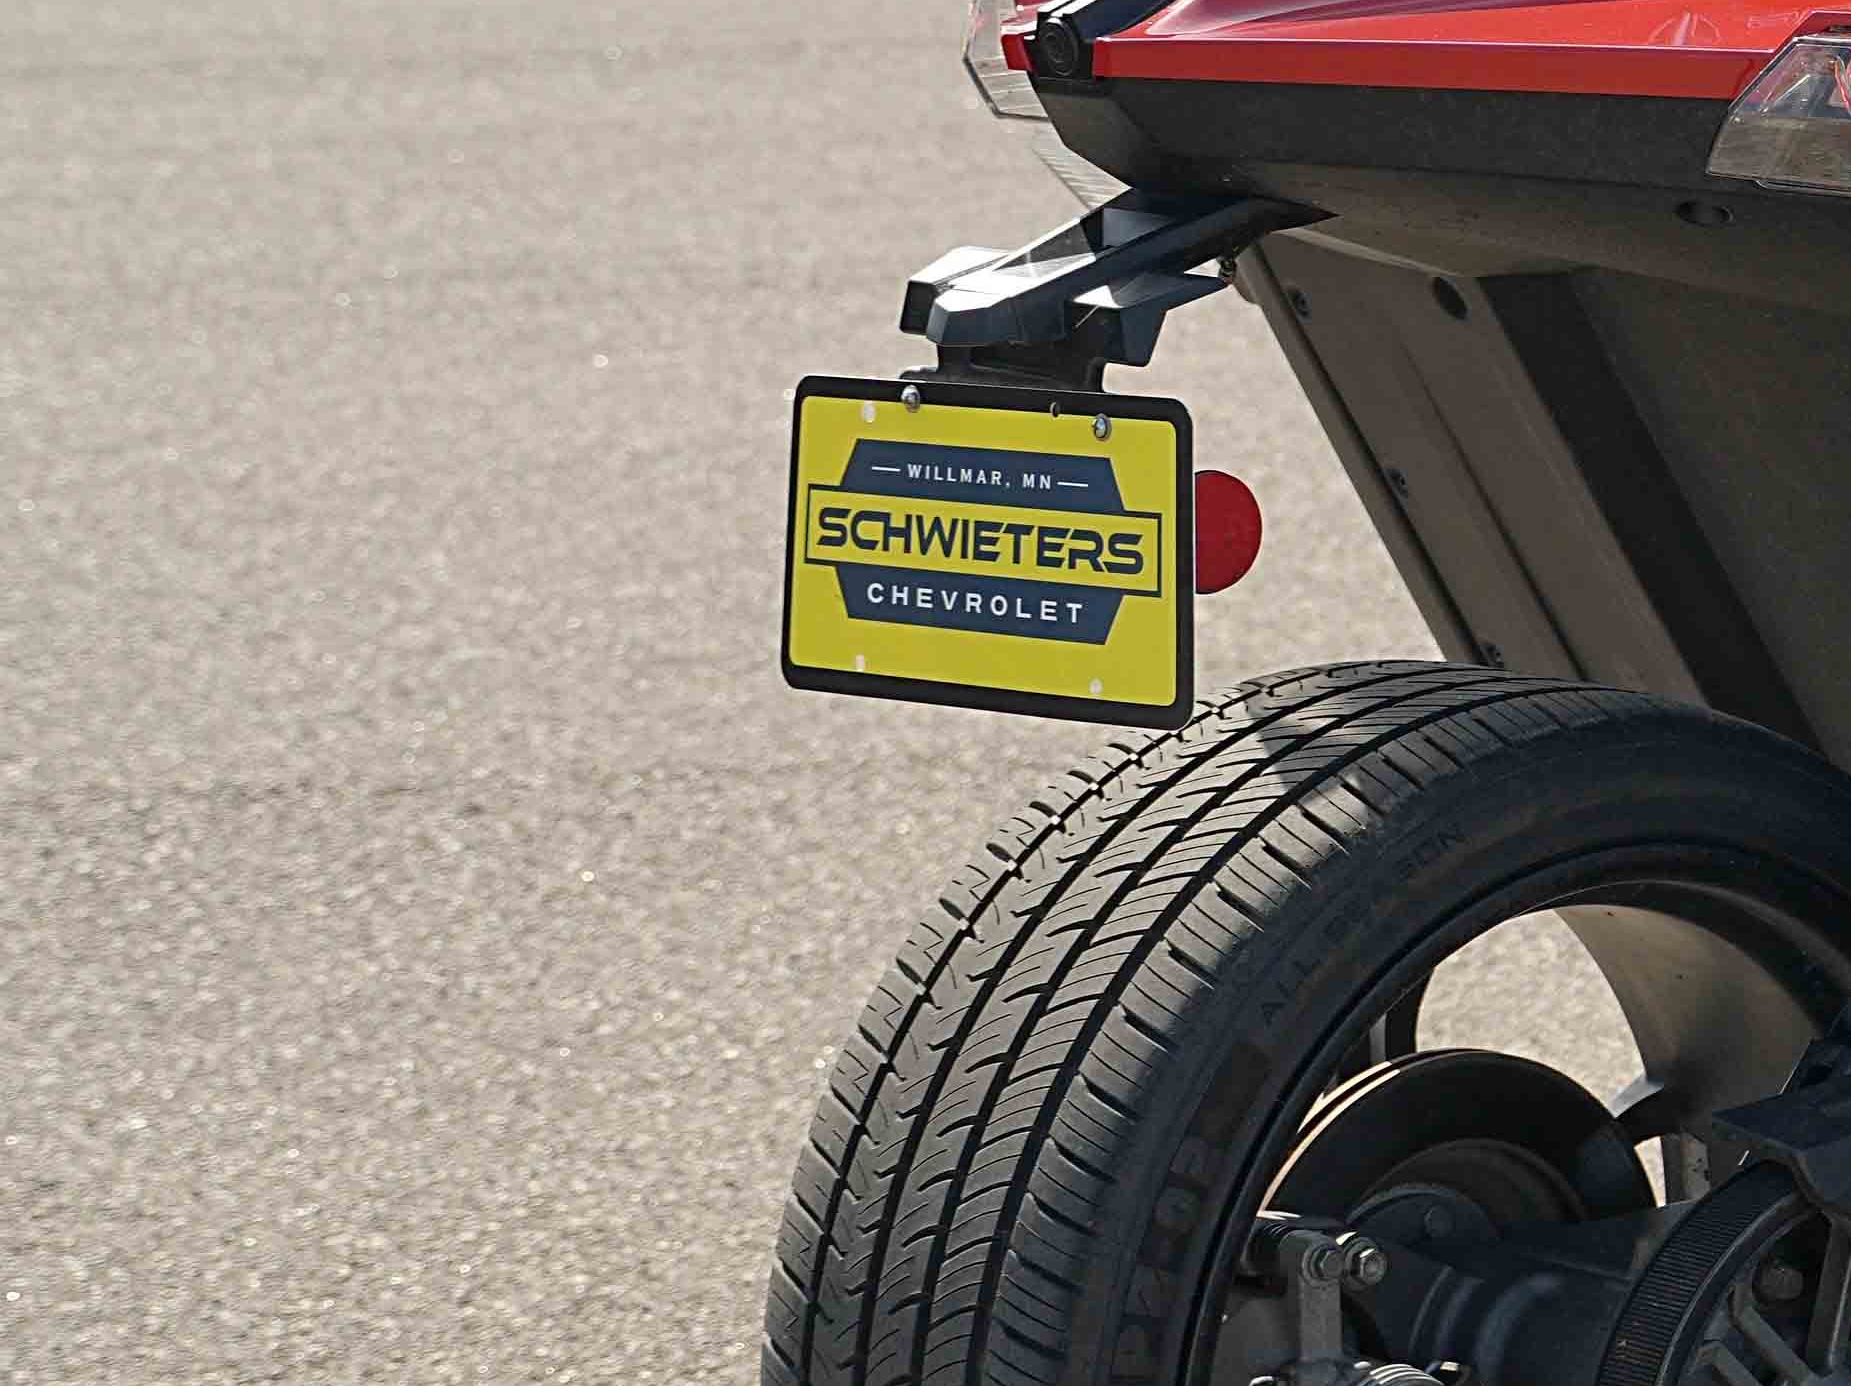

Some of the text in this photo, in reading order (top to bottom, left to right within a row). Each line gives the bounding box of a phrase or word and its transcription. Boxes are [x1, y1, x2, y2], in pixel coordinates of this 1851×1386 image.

[1022, 472, 1052, 490] MN
[816, 506, 1145, 575] SCHWIETERS
[866, 581, 1084, 624] CHEVROLET
